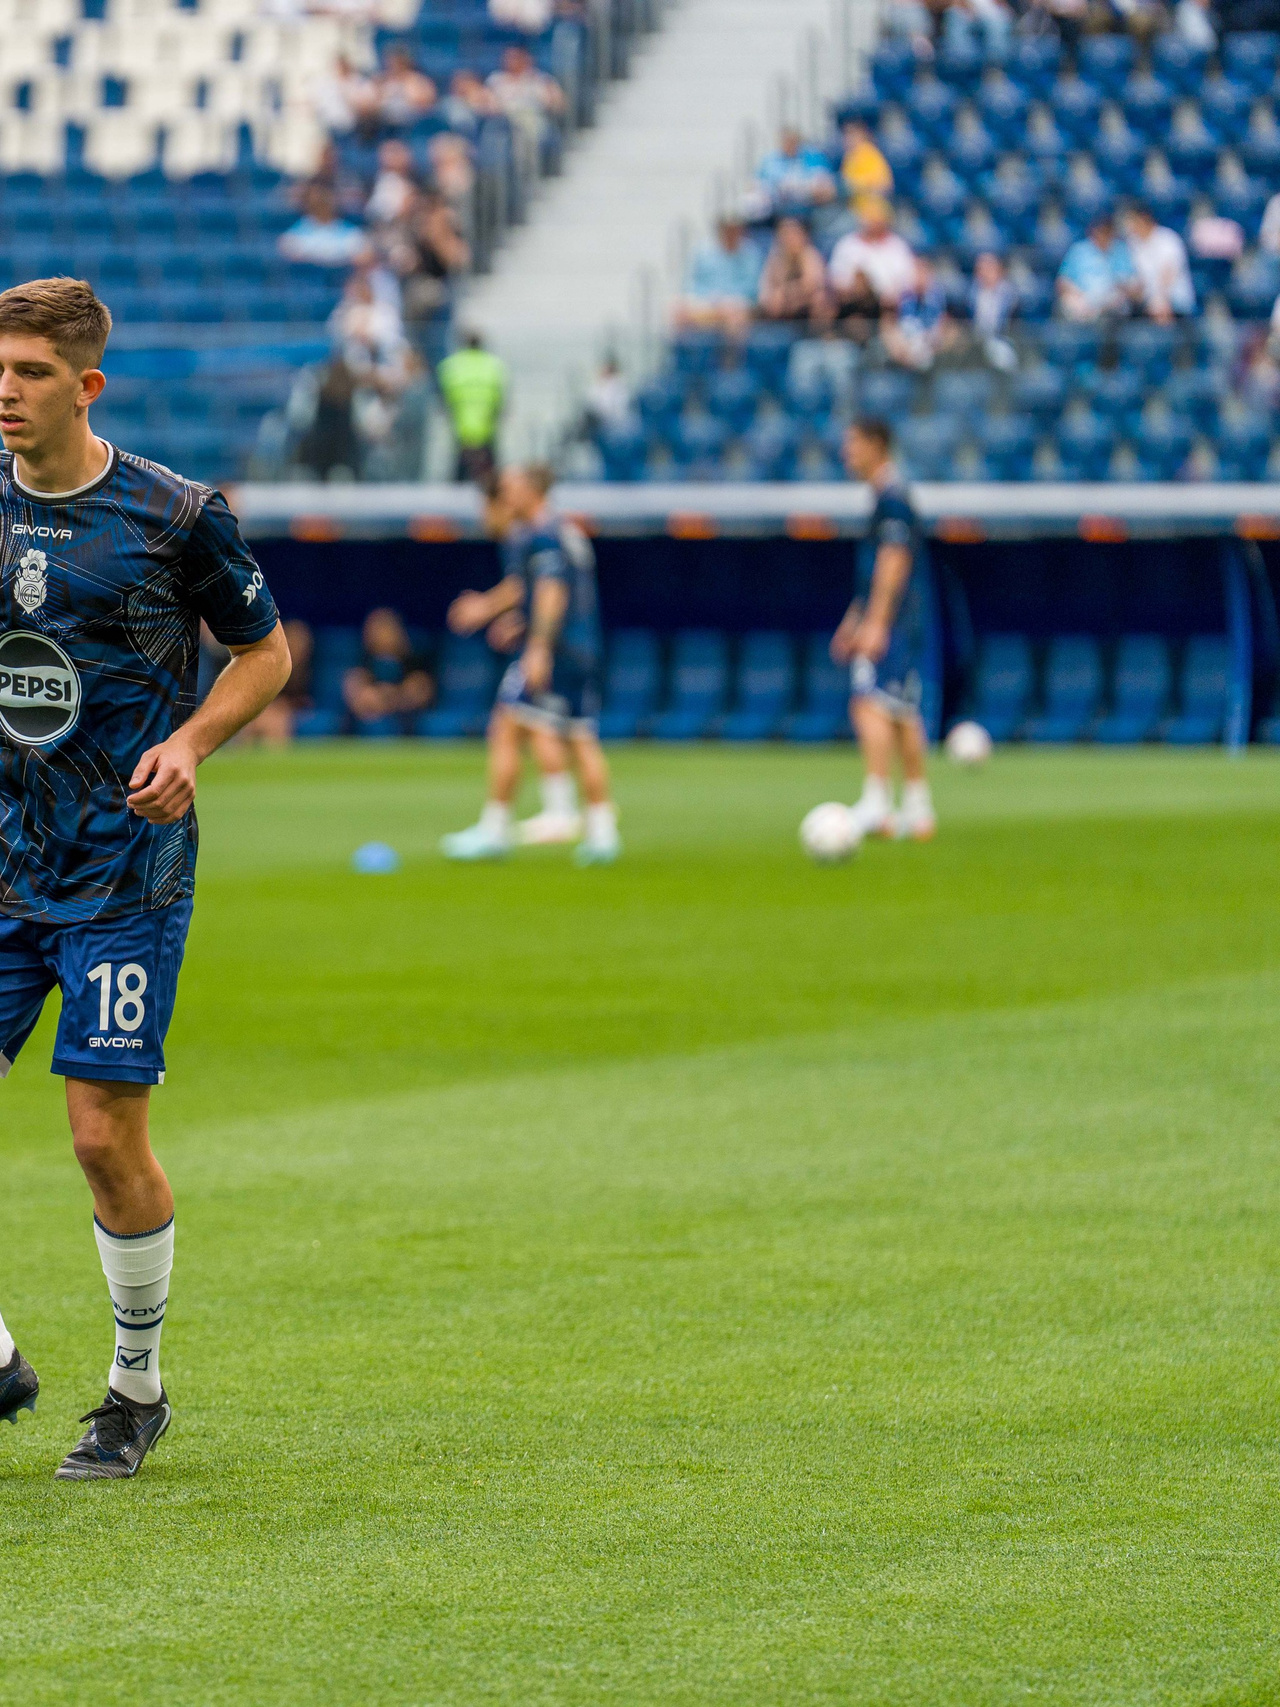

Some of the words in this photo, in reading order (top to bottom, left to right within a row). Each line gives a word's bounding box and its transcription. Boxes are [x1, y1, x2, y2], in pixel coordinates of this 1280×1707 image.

[11, 523, 73, 540] GIVOVA
[86, 962, 148, 1032] 18
[88, 1036, 144, 1049] GIVOVA
